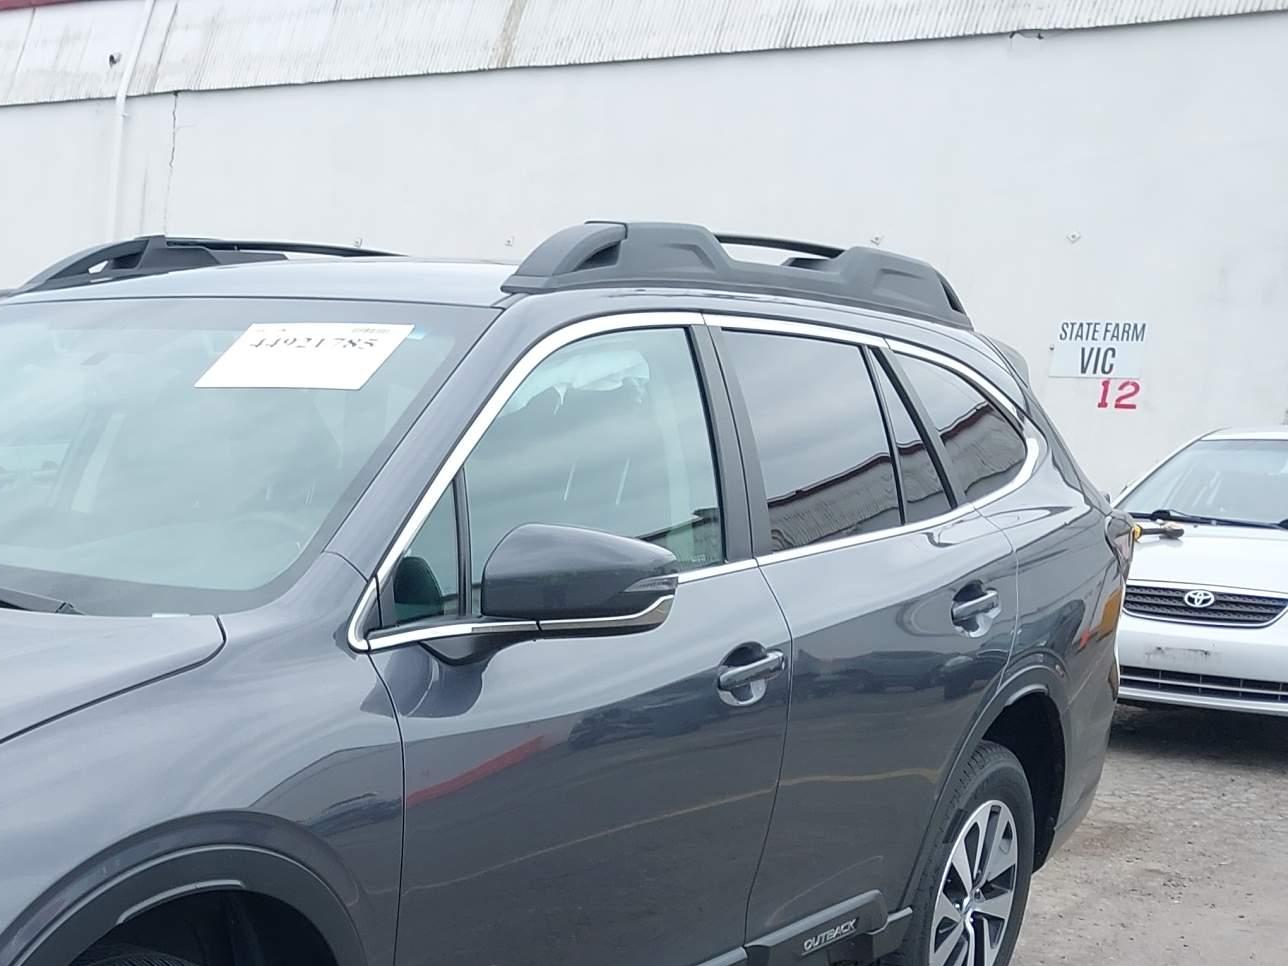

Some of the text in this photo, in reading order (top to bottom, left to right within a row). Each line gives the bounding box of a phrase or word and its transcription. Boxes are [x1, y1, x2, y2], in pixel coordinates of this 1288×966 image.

[1059, 322, 1146, 342] STATE FARM
[1080, 347, 1116, 375] VIC
[1097, 380, 1140, 409] 12
[804, 919, 857, 951] OUTBACK
